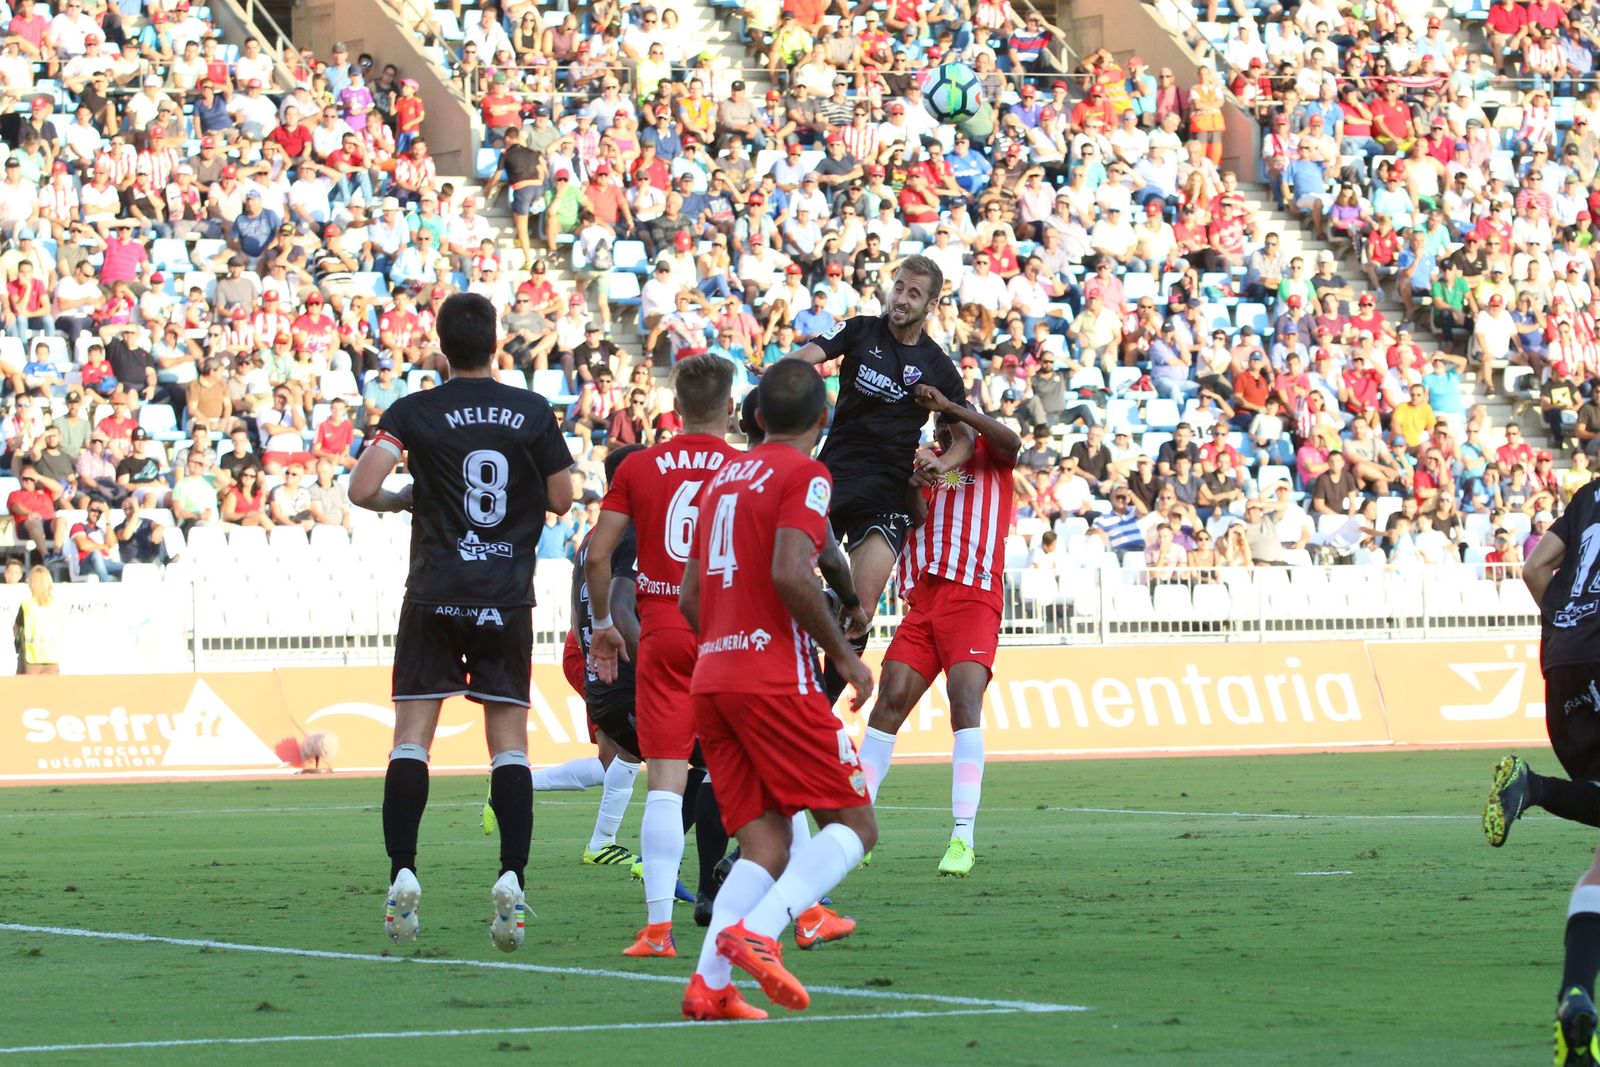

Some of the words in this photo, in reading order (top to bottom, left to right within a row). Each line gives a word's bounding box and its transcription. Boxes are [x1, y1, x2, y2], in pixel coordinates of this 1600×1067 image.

[445, 407, 526, 430] MELERO
[655, 450, 724, 475] MAND
[463, 450, 509, 527] 8
[665, 480, 704, 563] 6
[706, 493, 739, 589] 4
[647, 581, 671, 595] COSTA
[918, 656, 1362, 732] Aimentaria
[22, 706, 223, 743] Serfruit
[37, 755, 157, 769] automation
[81, 744, 163, 758] process
